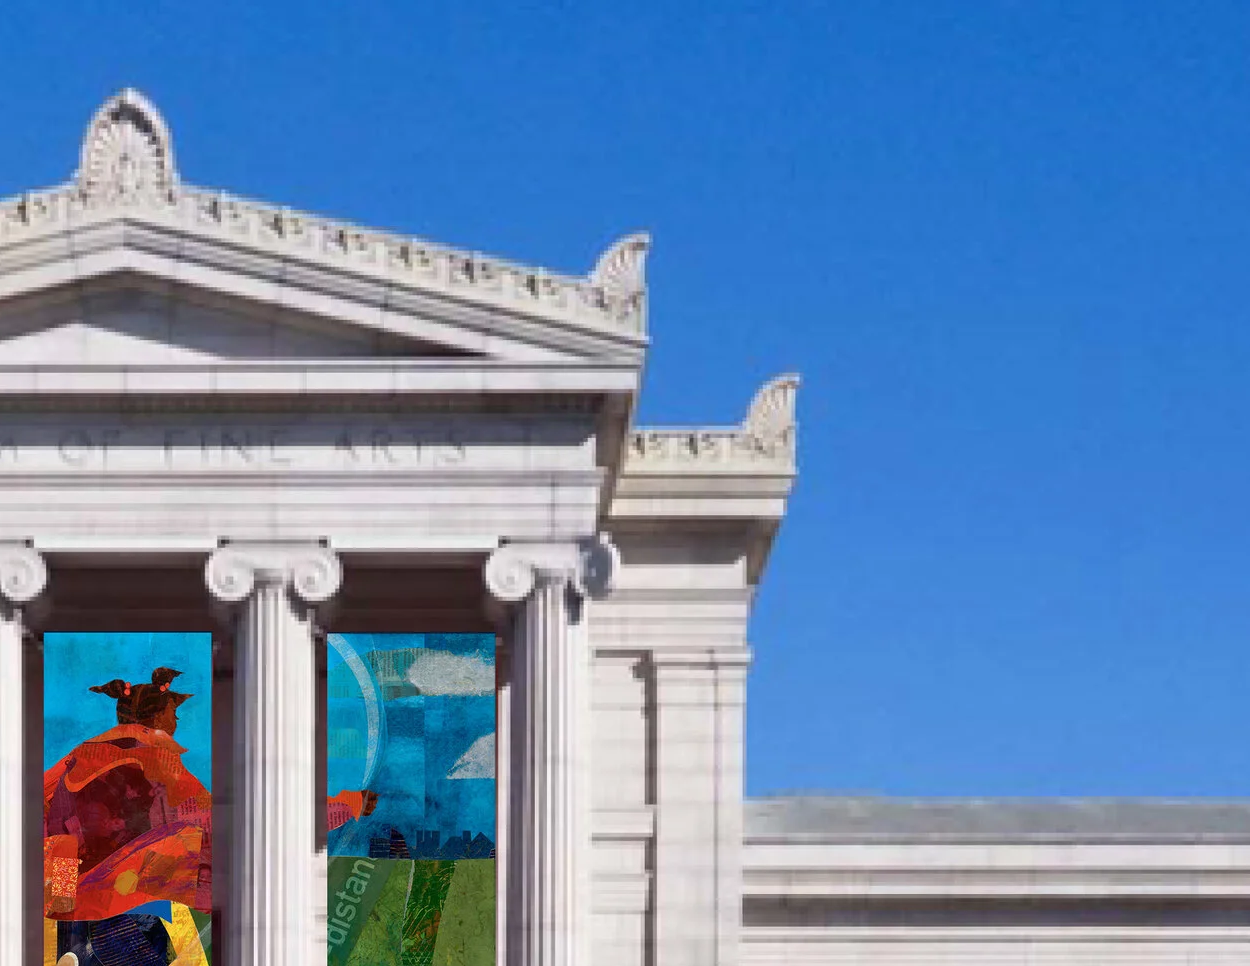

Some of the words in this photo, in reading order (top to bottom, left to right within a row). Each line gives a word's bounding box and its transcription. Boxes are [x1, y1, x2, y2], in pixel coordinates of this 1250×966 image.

[58, 428, 120, 466] OF
[163, 428, 291, 466] FINE
[334, 428, 466, 464] ARTS
[327, 858, 376, 945] distan
